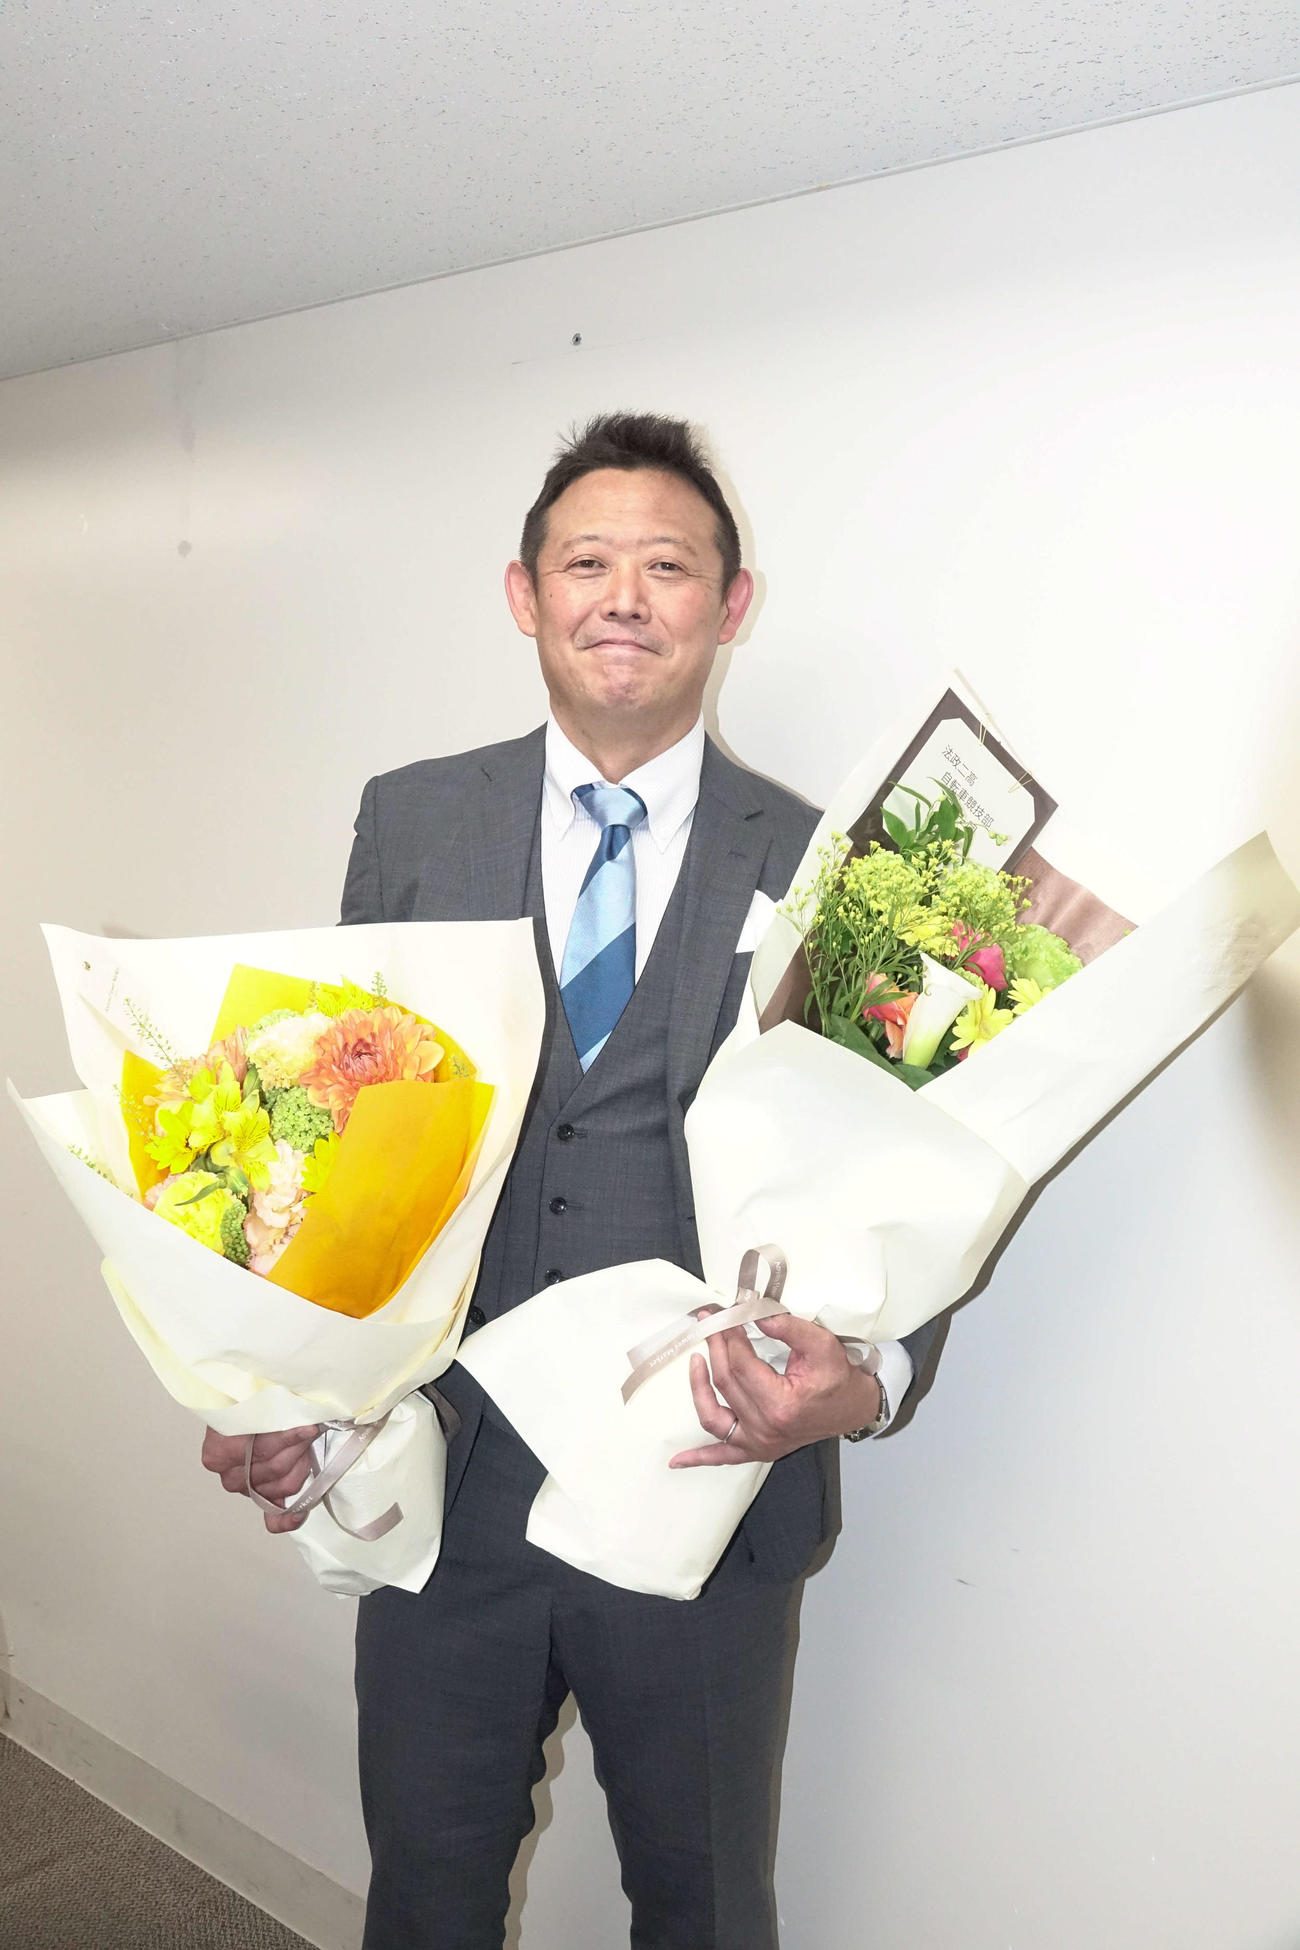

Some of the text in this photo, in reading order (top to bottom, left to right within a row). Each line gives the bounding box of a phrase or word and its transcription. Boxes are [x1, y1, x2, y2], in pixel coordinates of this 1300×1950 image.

[942, 744, 978, 787] 法政二高
[941, 771, 994, 828] 自転車競技部
